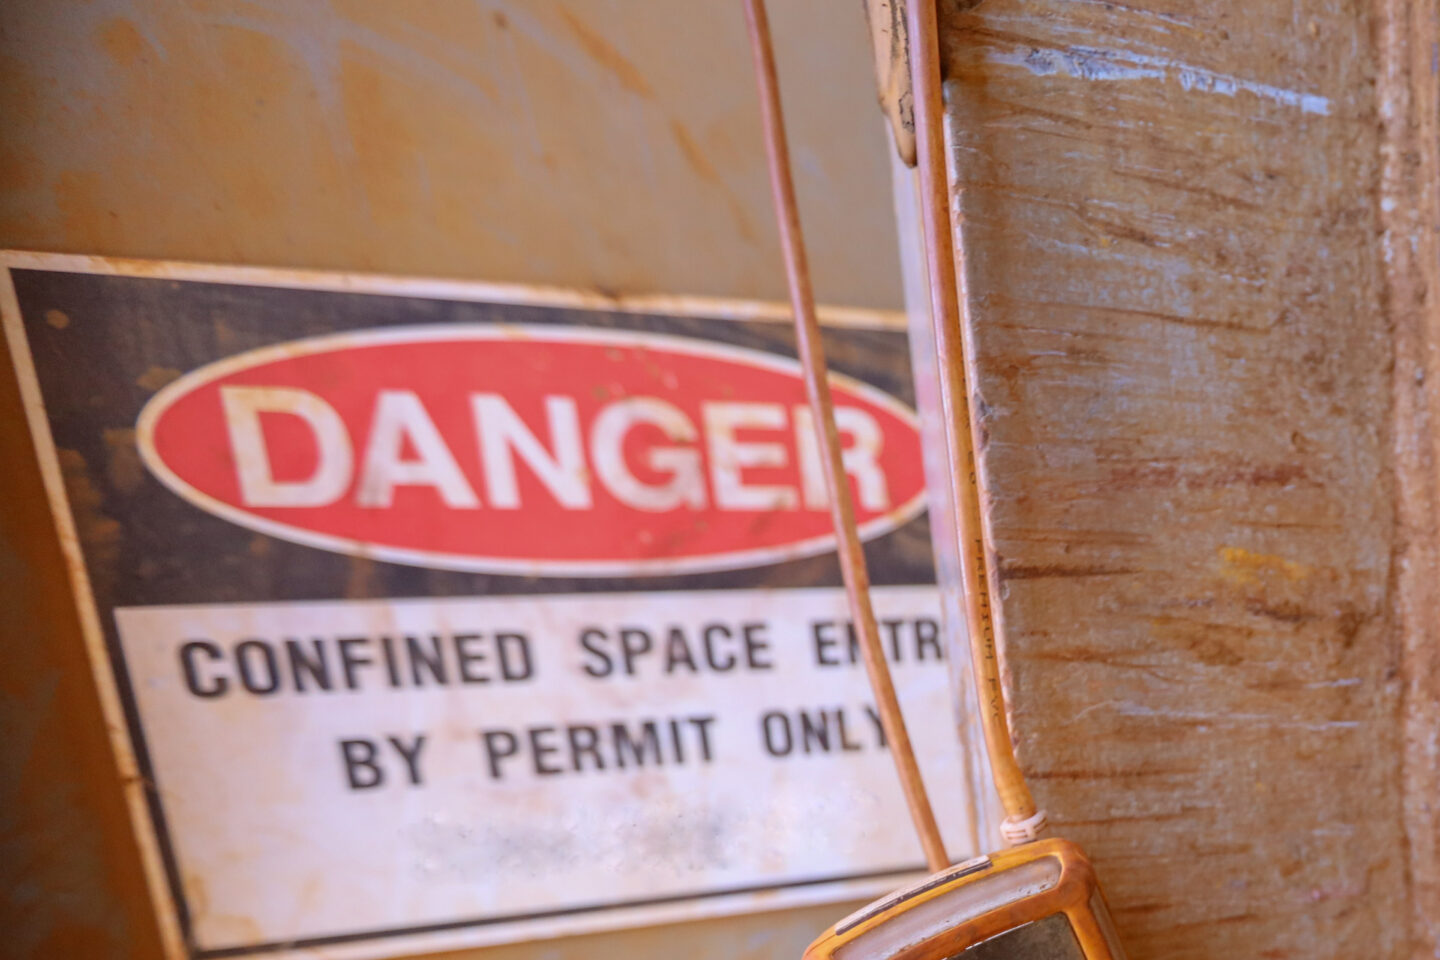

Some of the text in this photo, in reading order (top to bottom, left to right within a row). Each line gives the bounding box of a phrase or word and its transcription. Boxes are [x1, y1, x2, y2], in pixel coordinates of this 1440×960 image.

[220, 384, 891, 512] DANGER
[179, 617, 944, 699] CONFINED SPACE ETR
[341, 736, 427, 790] BY
[486, 717, 718, 780] PERMIT
